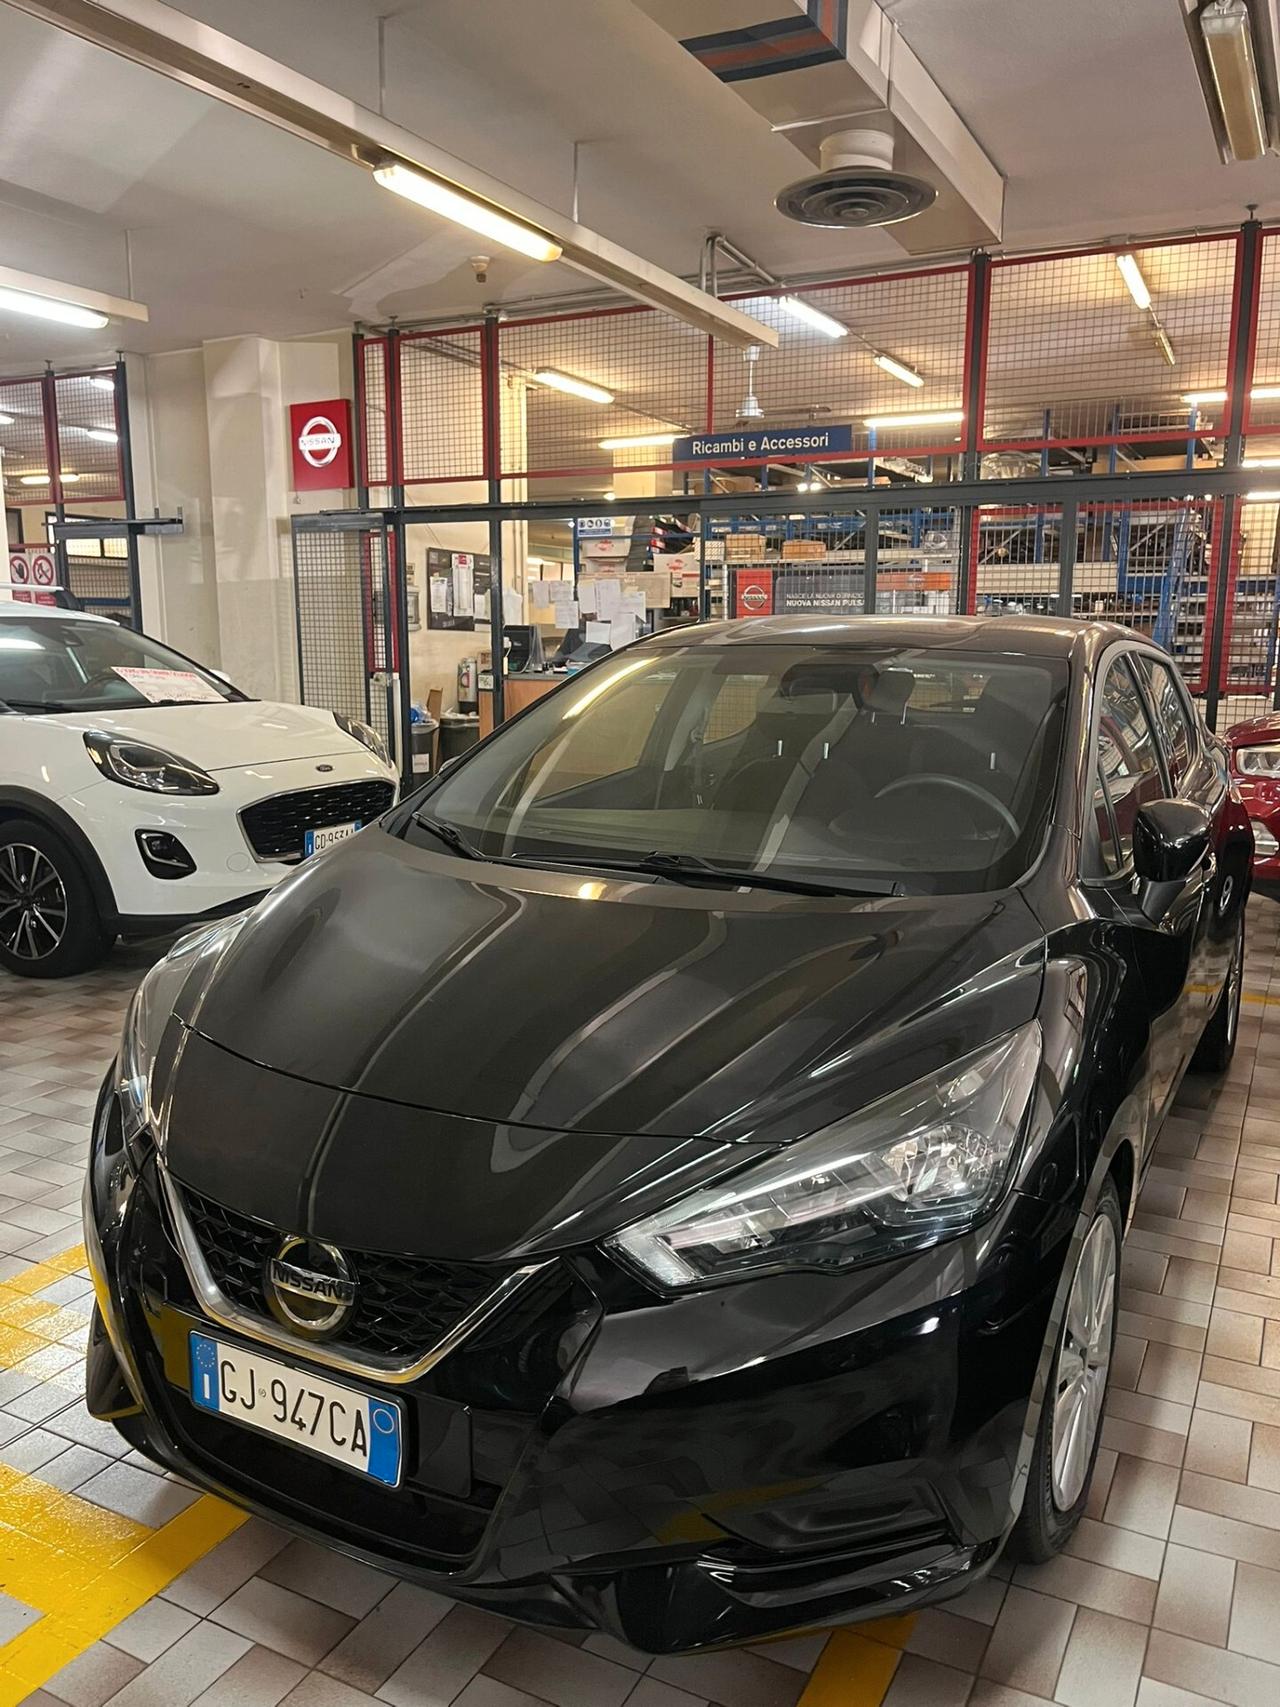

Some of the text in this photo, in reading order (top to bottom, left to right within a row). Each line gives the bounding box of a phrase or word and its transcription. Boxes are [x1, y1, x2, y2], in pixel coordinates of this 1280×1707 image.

[692, 432, 829, 455] Ricambi e Accessori
[786, 599, 812, 607] NUOVA
[813, 599, 841, 607] NISSAN
[273, 1260, 342, 1299] NISSAN
[220, 1360, 367, 1457] GJ 947CA
